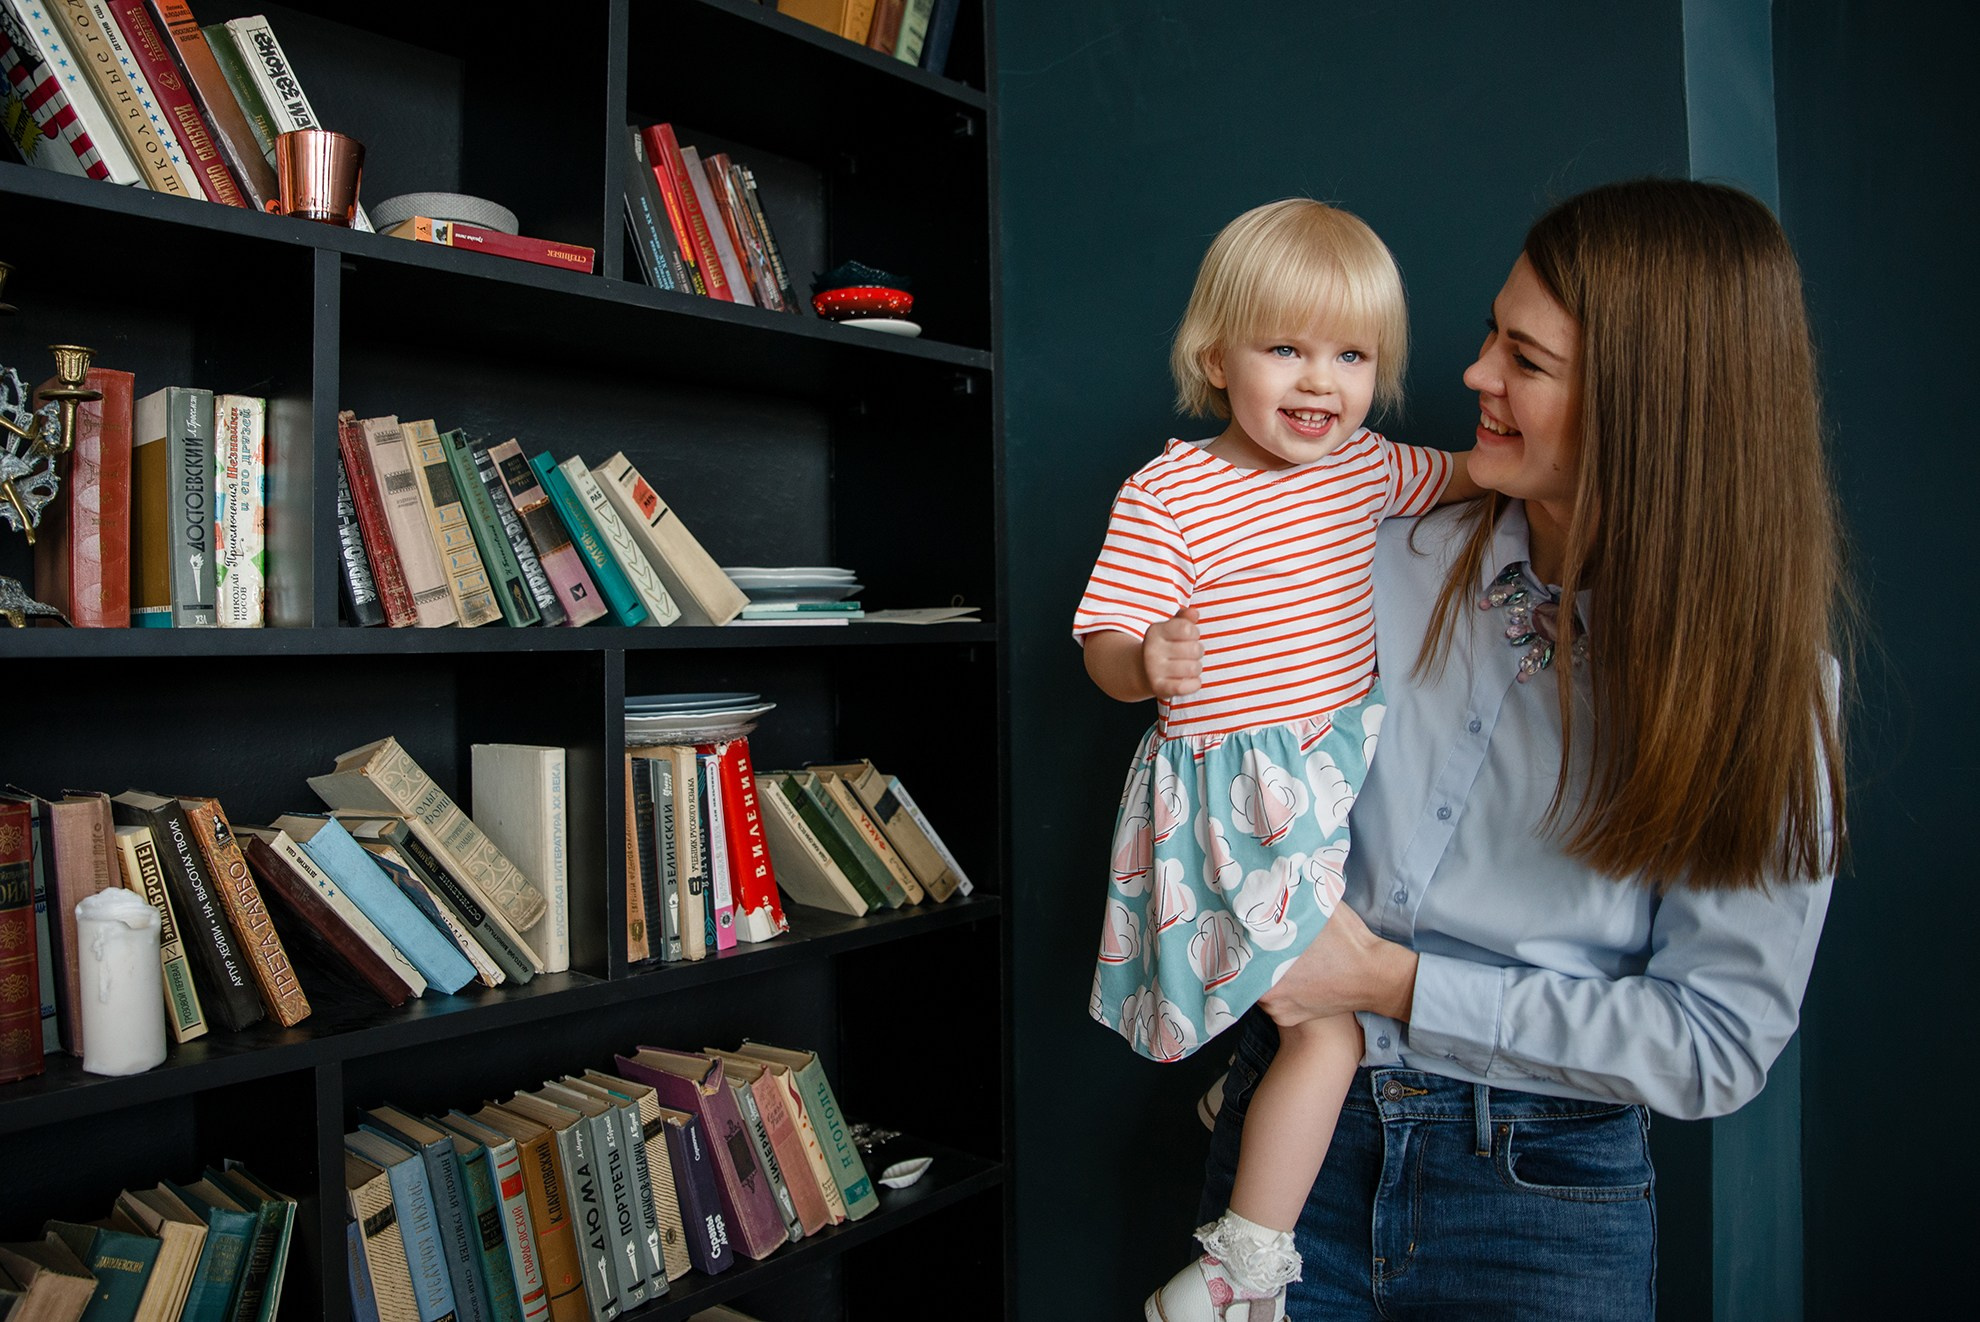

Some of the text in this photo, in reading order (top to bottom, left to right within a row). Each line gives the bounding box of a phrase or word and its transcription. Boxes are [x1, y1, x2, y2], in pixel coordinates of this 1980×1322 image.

[93, 3, 122, 52] ДЕТЕКТИВ США
[173, 99, 217, 163] САЛЬГАРИ
[546, 247, 586, 264] СТЕЙНБЕК
[679, 178, 724, 288] БЕНДЖАМИН СПОК
[653, 266, 664, 288] усская
[238, 408, 251, 464] друзей
[182, 437, 206, 552] ДОСТОЕВСКИЙ
[224, 407, 242, 566] Приключения Незнайки
[240, 469, 249, 494] его
[489, 485, 556, 609] УГРЮМ-РЕКА
[230, 573, 240, 619] НИКОЛАЙ
[414, 786, 441, 817] ОЛЬГА
[424, 795, 451, 826] ФОРШ
[686, 777, 699, 872] УЧЕБНИК РУССКОГО ЯЗЫКА
[166, 817, 190, 853] ТВОИХ
[283, 844, 318, 878] ДЕТЕКТИВ США
[551, 762, 565, 936] РУССКАЯ ЛИТЕРАТУРА XX ВЕКА
[662, 803, 676, 884] ЗЕЛИНСКИЙ
[137, 846, 167, 907] БРОНТЕ
[180, 852, 209, 901] ВЫСОТАХ
[434, 870, 485, 921] ОСУЖДЕНИЕ
[201, 901, 215, 918] НА
[223, 858, 300, 998] ГРЕТА ГАРБО
[209, 925, 232, 958] ХЕЙЛИ
[167, 961, 195, 1024] ГРОЗОВОЙ ПЕРЕВАЛ
[224, 958, 244, 988] АРТУР
[755, 1120, 780, 1184] ЧИЧЕРИН
[441, 1157, 459, 1209] НИКОЛАЙ
[451, 1211, 470, 1263] ГУМИЛЕВ
[578, 1163, 605, 1251] ДЮМА
[607, 1148, 632, 1237] ПОРТРЕТЫ
[634, 1141, 656, 1228] САЛТЫКОВ-ЩЕДРИН
[408, 1180, 445, 1308] ЭРСКИН КОЛДУЭЛЛ
[704, 1214, 722, 1259] Страны
[713, 1213, 728, 1245] мира
